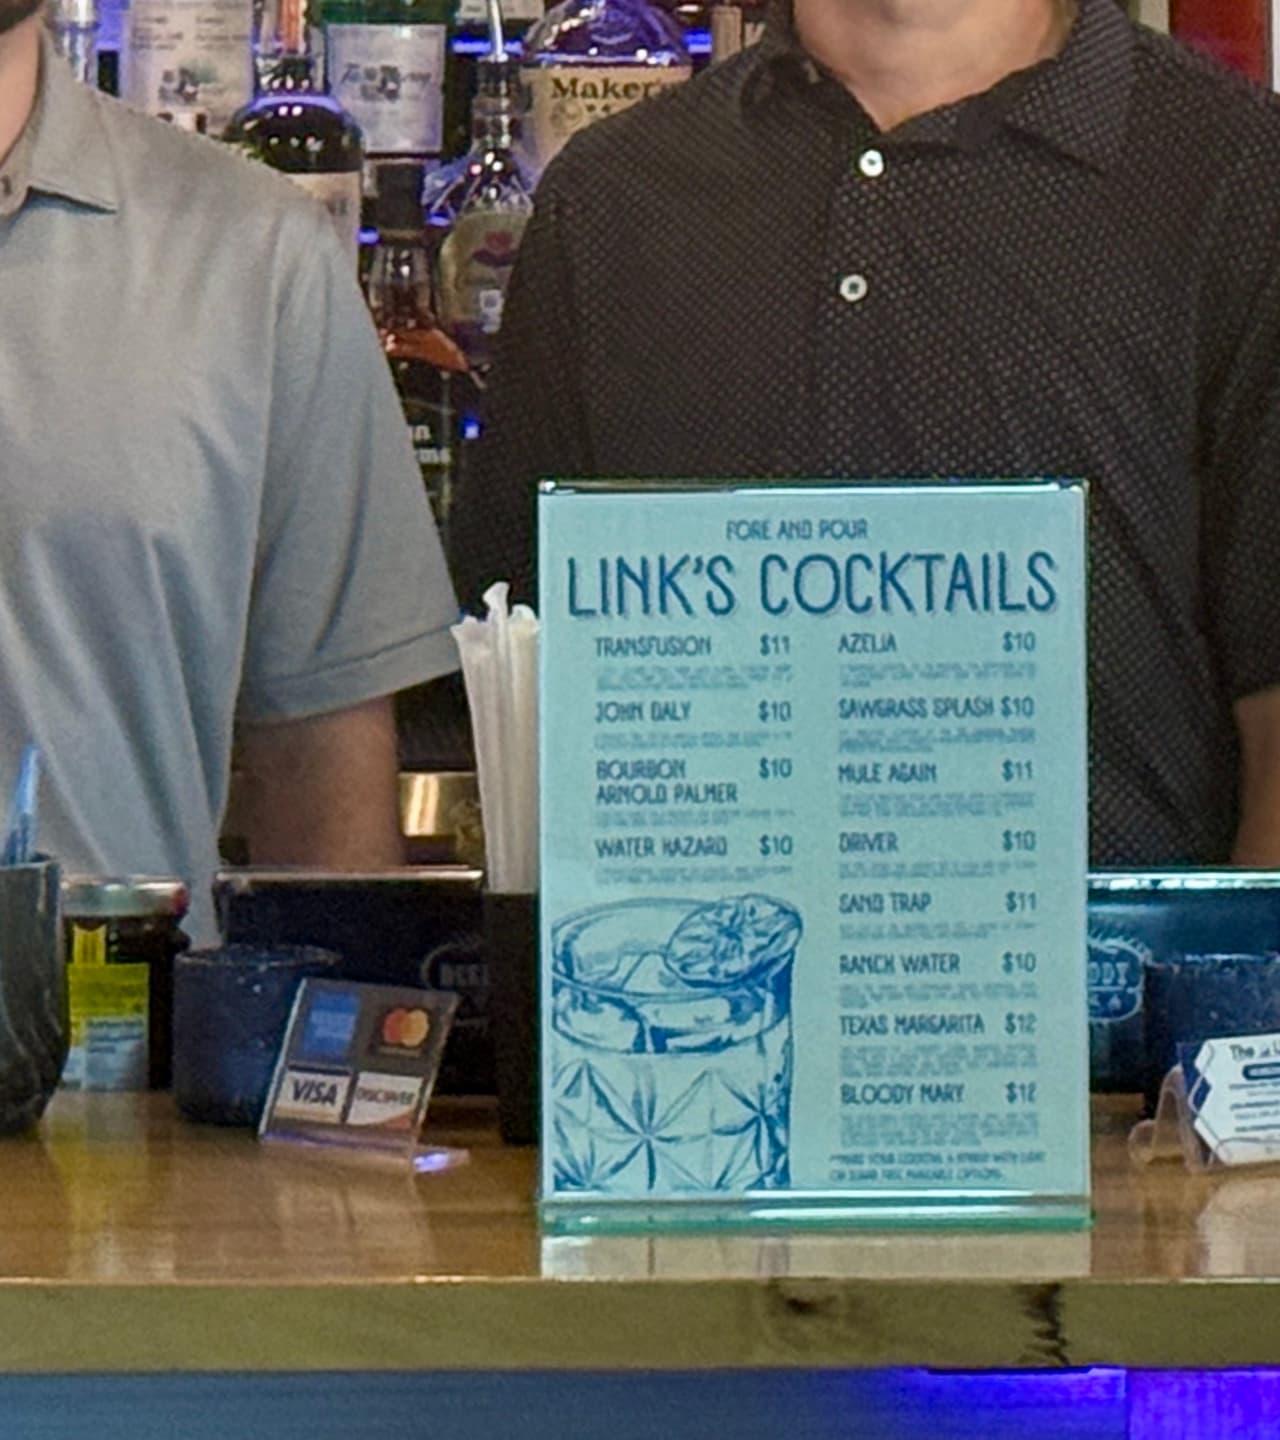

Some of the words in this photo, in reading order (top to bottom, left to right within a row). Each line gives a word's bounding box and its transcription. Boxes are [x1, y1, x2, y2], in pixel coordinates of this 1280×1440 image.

[550, 75, 668, 101] Maker'
[726, 519, 771, 541] FORE
[778, 519, 813, 541] AND
[819, 518, 868, 540] POUR
[567, 553, 736, 617] LINK'S
[760, 550, 1057, 615] COCKTAILS
[595, 634, 712, 658] TRANSFUSION
[759, 633, 791, 657] $11
[1002, 631, 1036, 653] $10
[595, 701, 644, 723] JOHN
[650, 701, 691, 722] DALY
[758, 700, 792, 723] $10
[838, 697, 928, 719] SAWGRASS
[933, 697, 994, 718] SPLASH
[1001, 696, 1036, 718] $10
[596, 759, 686, 781] BOURBON
[759, 757, 793, 779] $10
[838, 762, 882, 784] MULE
[888, 762, 937, 783] AGAIN
[1002, 760, 1034, 782] $11
[596, 783, 668, 805] ARNOLD
[673, 782, 739, 804] PALMER
[595, 836, 655, 858] WATER
[661, 835, 728, 857] HAZARD
[759, 834, 793, 856] $10
[839, 831, 899, 853] DRIVER
[1002, 829, 1036, 852] $10
[839, 893, 884, 914] SAND
[889, 892, 932, 913] TRAP
[1005, 891, 1037, 913] $11
[839, 953, 895, 975] RANCH
[901, 952, 961, 974] WATER
[1002, 951, 1037, 974] $10
[839, 1014, 889, 1035] TEXAS
[894, 1013, 985, 1035] MARGARITA
[1005, 1012, 1037, 1034] $12
[1229, 1044, 1255, 1060] The
[292, 1078, 339, 1107] VISA
[840, 1083, 914, 1105] BLOODY
[920, 1083, 965, 1104] MARY
